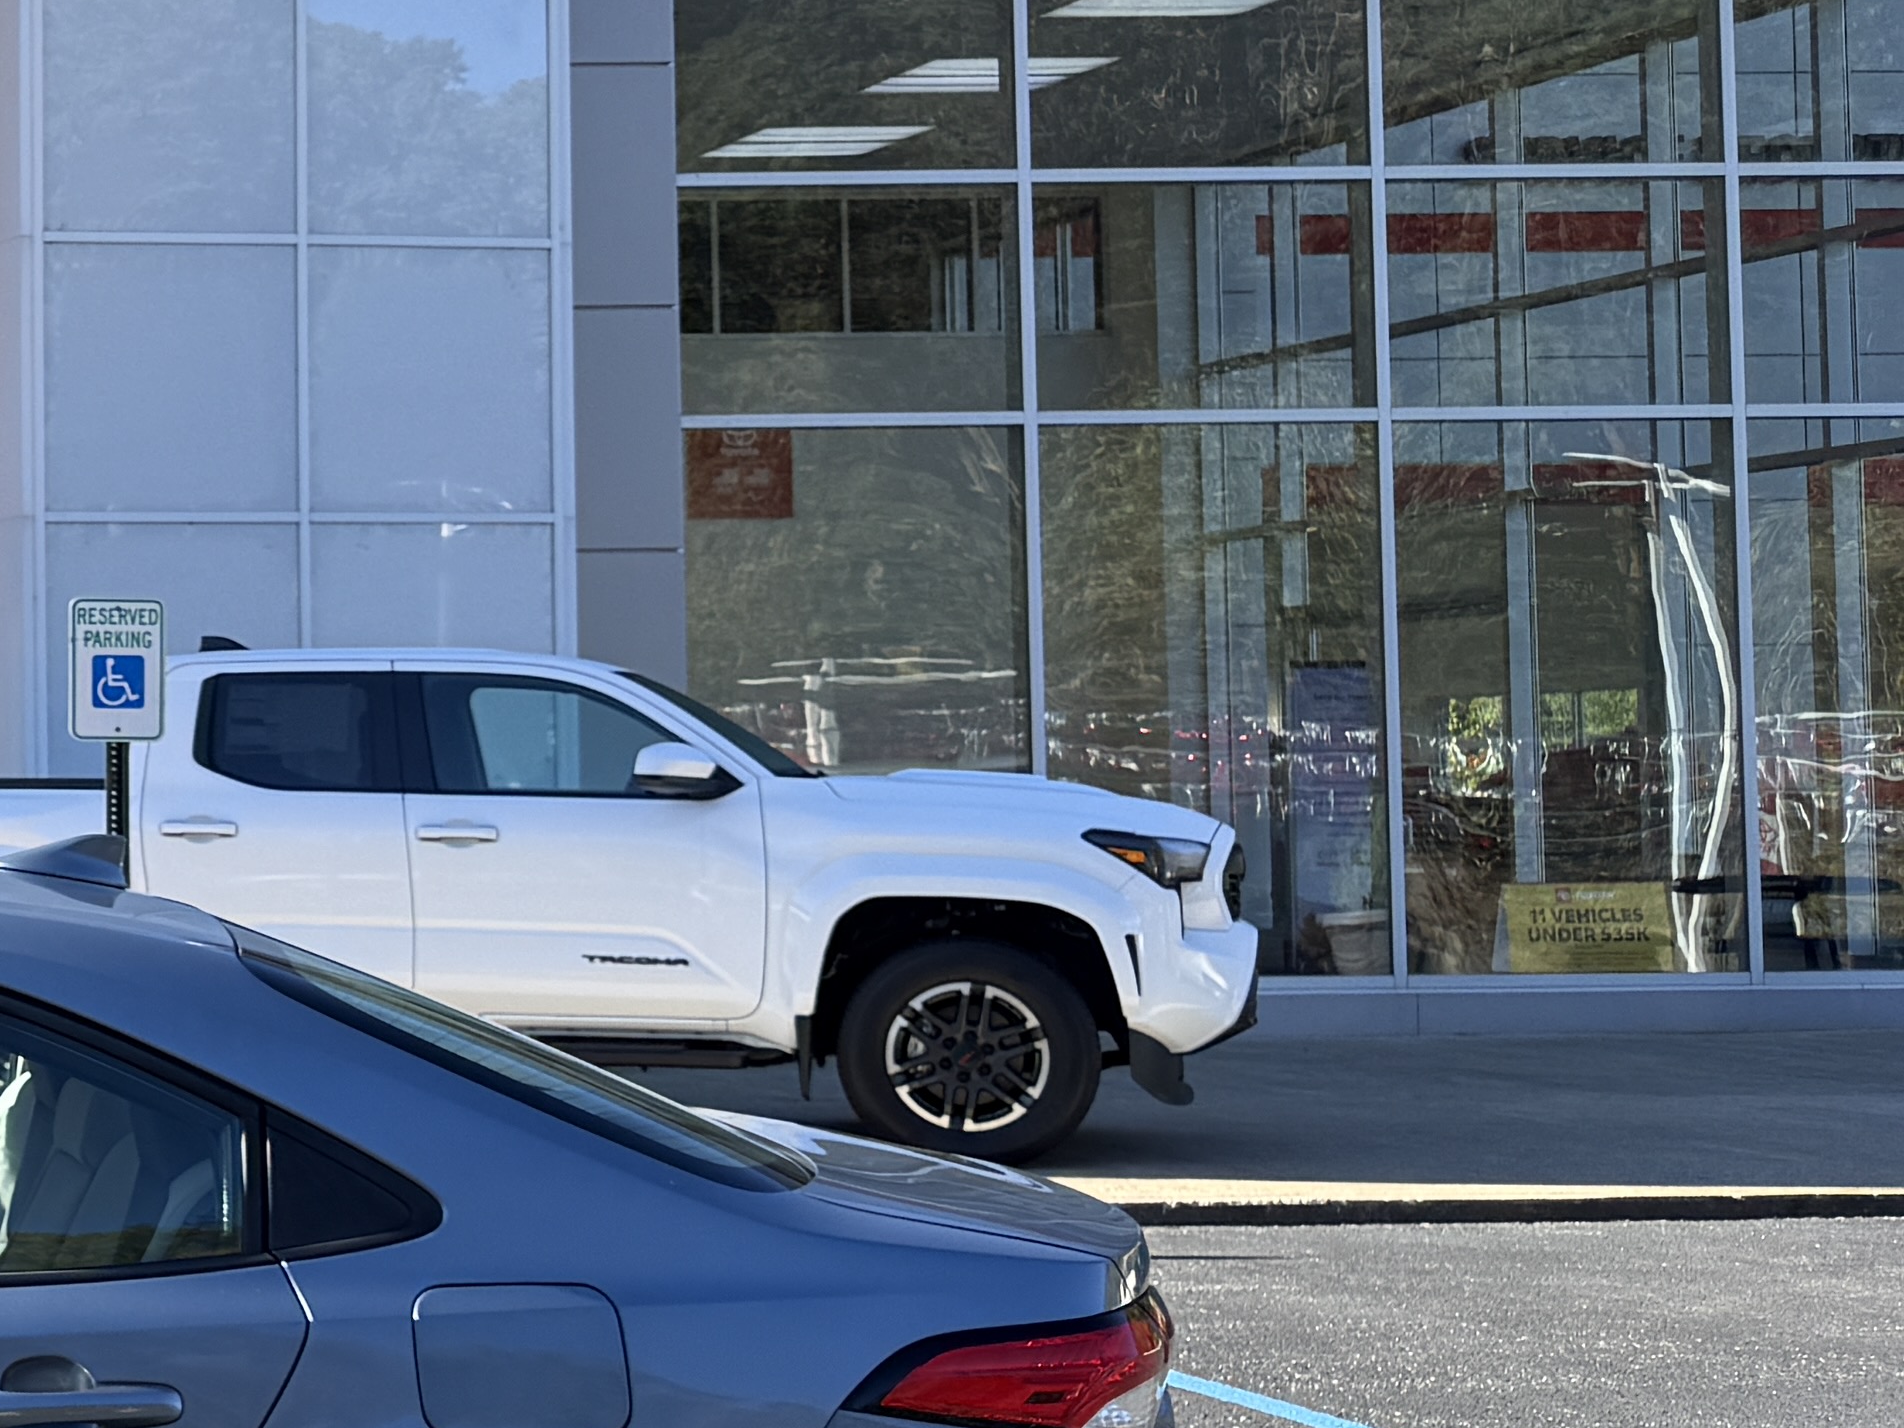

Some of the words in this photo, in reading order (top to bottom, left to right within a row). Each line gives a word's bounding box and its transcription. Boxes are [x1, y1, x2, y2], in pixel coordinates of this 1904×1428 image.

[77, 607, 159, 626] RESERVED
[84, 630, 152, 649] PARKING
[1529, 908, 1546, 924] 11
[1551, 907, 1644, 924] VEHICLES
[1528, 926, 1596, 943] UNDER
[582, 954, 689, 967] TACOMA
